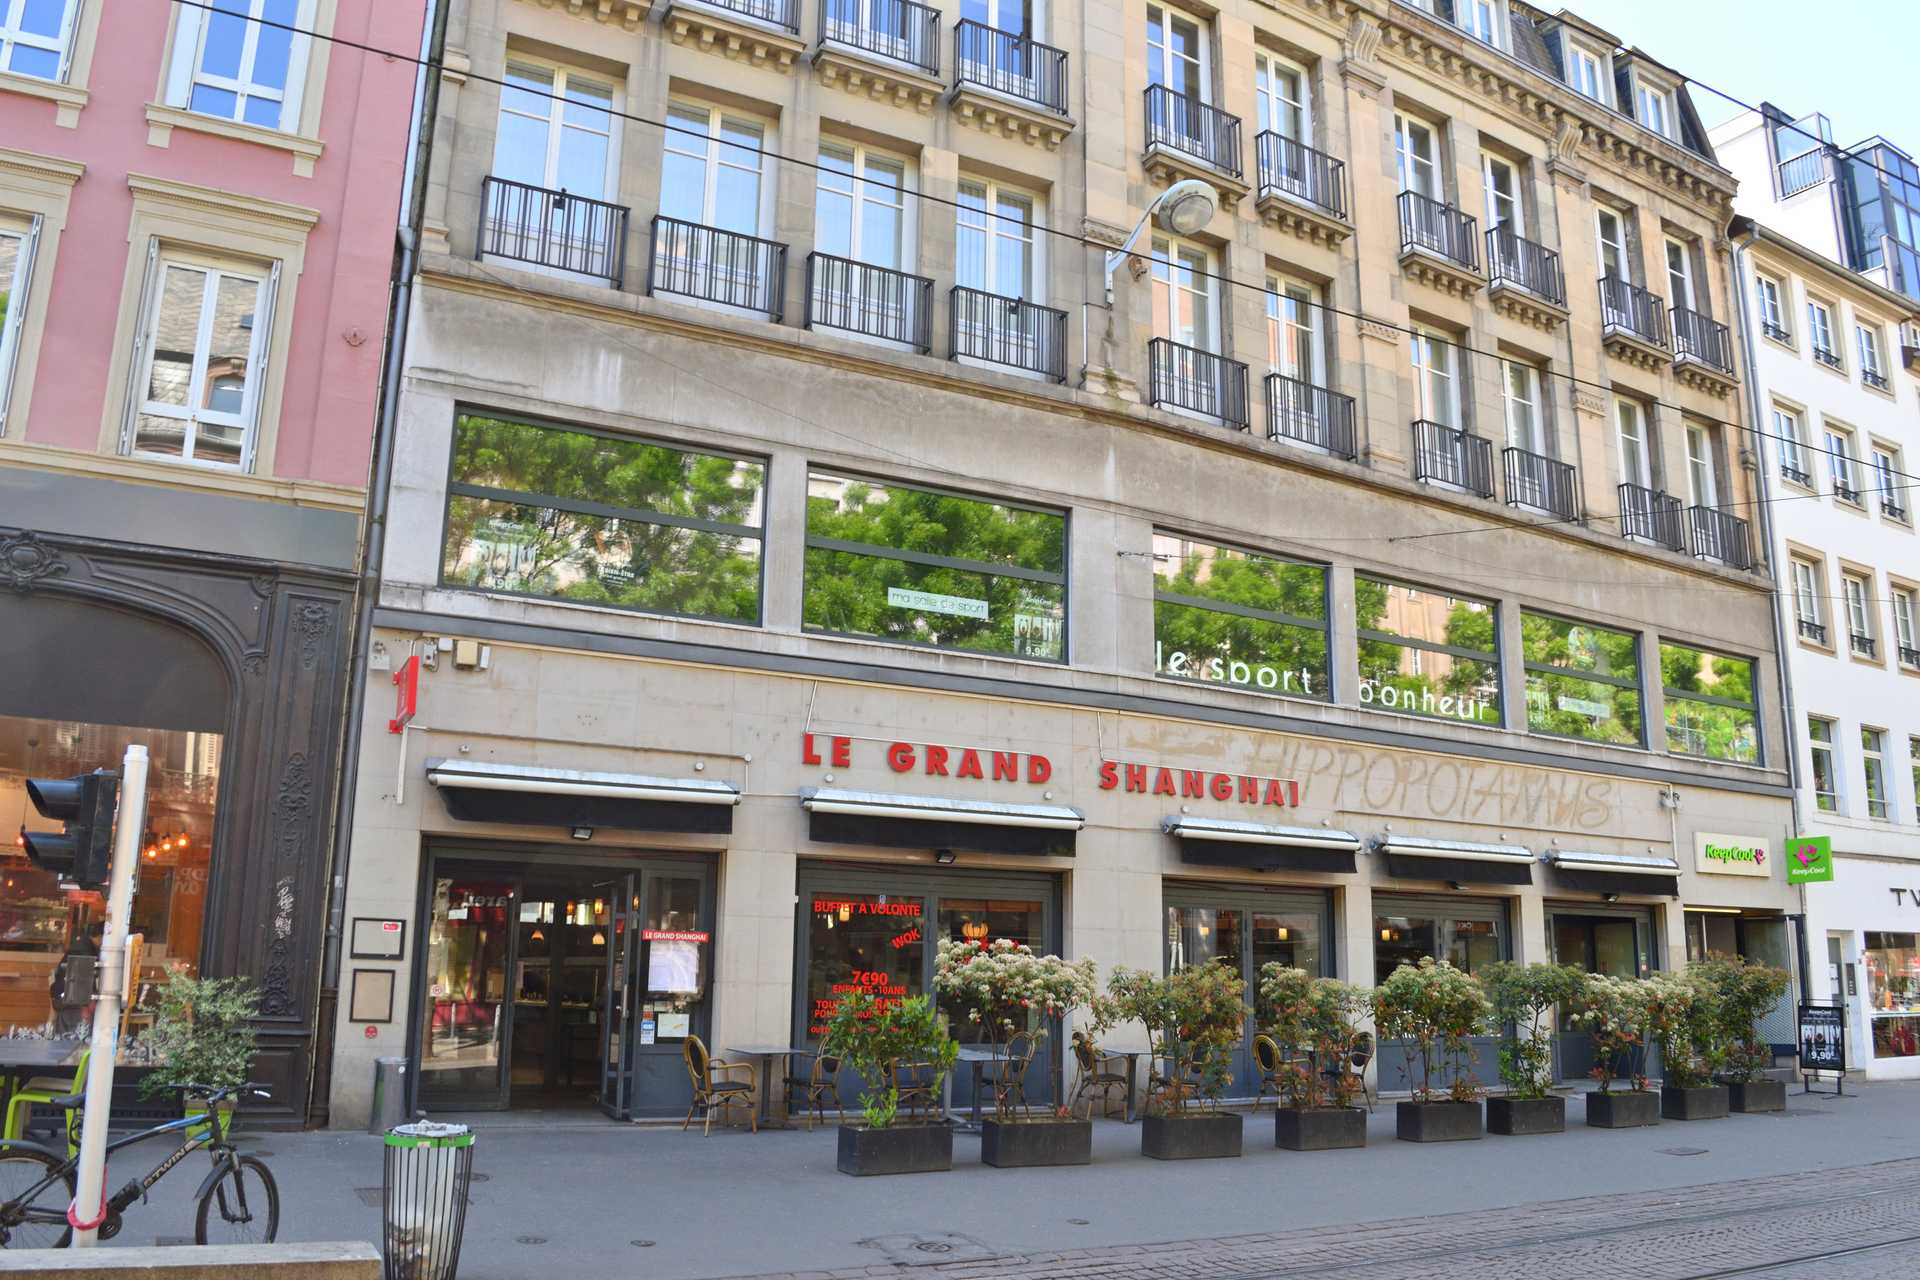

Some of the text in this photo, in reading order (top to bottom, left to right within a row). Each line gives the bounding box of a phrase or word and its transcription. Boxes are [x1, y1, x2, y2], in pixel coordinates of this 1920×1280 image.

[891, 591, 985, 616] ma salle de sport
[1155, 640, 1189, 676] le
[1358, 675, 1490, 721] bonheur
[802, 733, 1300, 808] LE GRAND SHANGHAI
[1250, 737, 1613, 829] HIPPOPOTAMUS
[1705, 844, 1754, 864] KeepCool
[1792, 867, 1826, 876] KeepCool
[814, 901, 855, 913] BUFFET
[645, 931, 706, 941] LE GRAND SHANGHAI
[890, 927, 921, 949] WOK
[851, 970, 889, 985] 7€90
